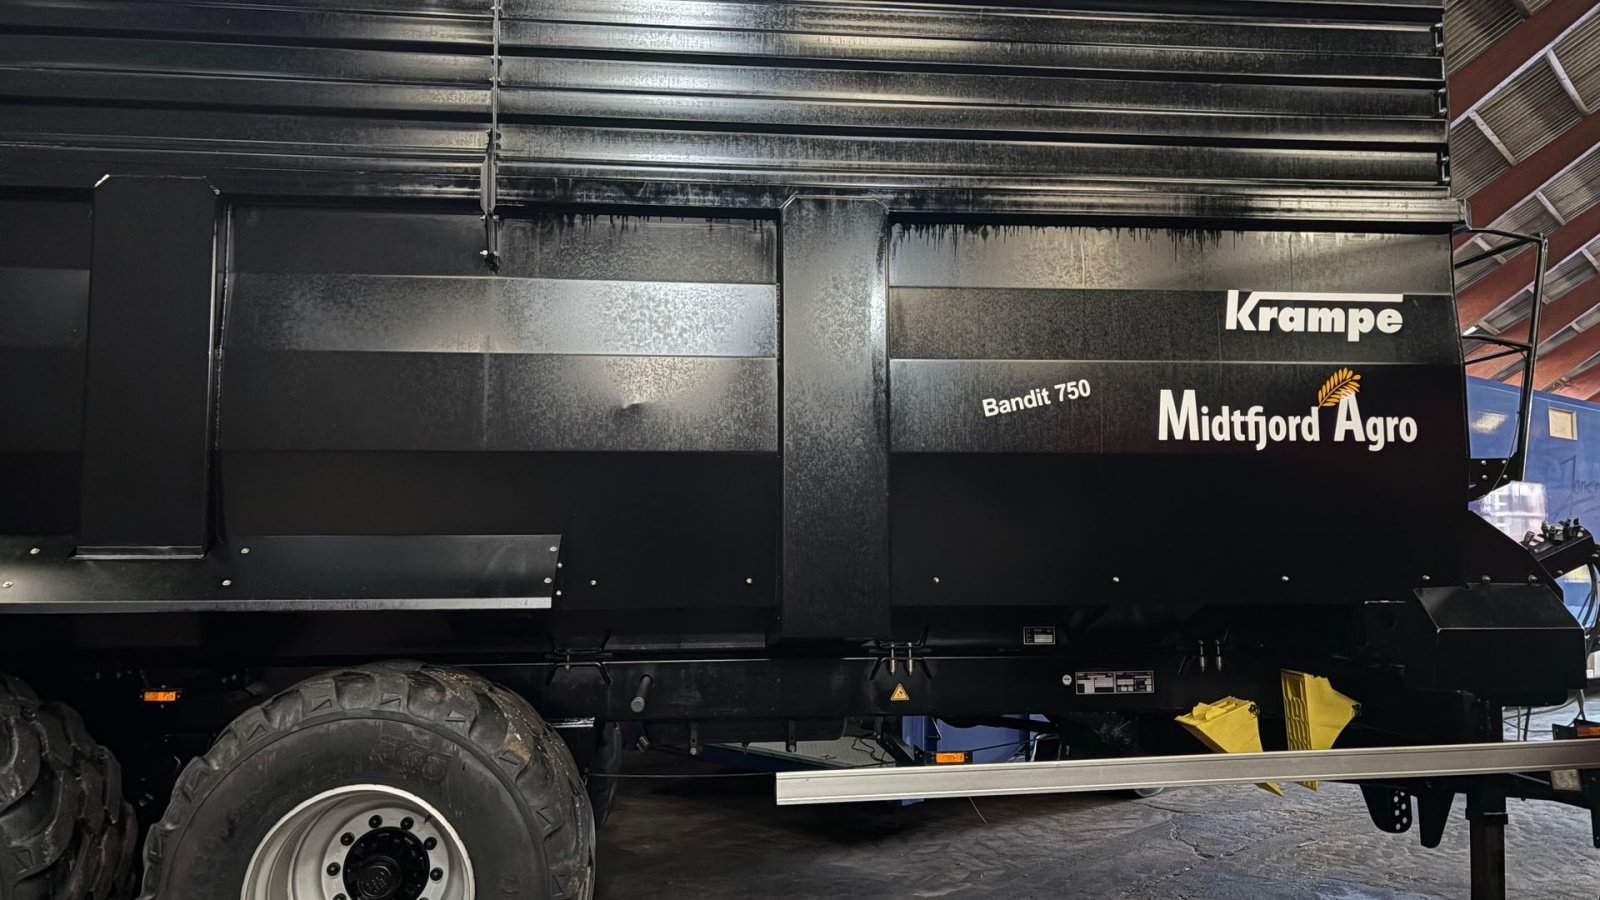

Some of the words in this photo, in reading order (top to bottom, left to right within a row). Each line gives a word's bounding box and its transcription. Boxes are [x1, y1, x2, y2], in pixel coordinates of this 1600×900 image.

[1225, 289, 1404, 342] Krampe
[982, 388, 1051, 417] Bandit
[1054, 379, 1091, 402] 750
[1158, 389, 1321, 451] Midtfjord
[1333, 389, 1419, 452] Agro
